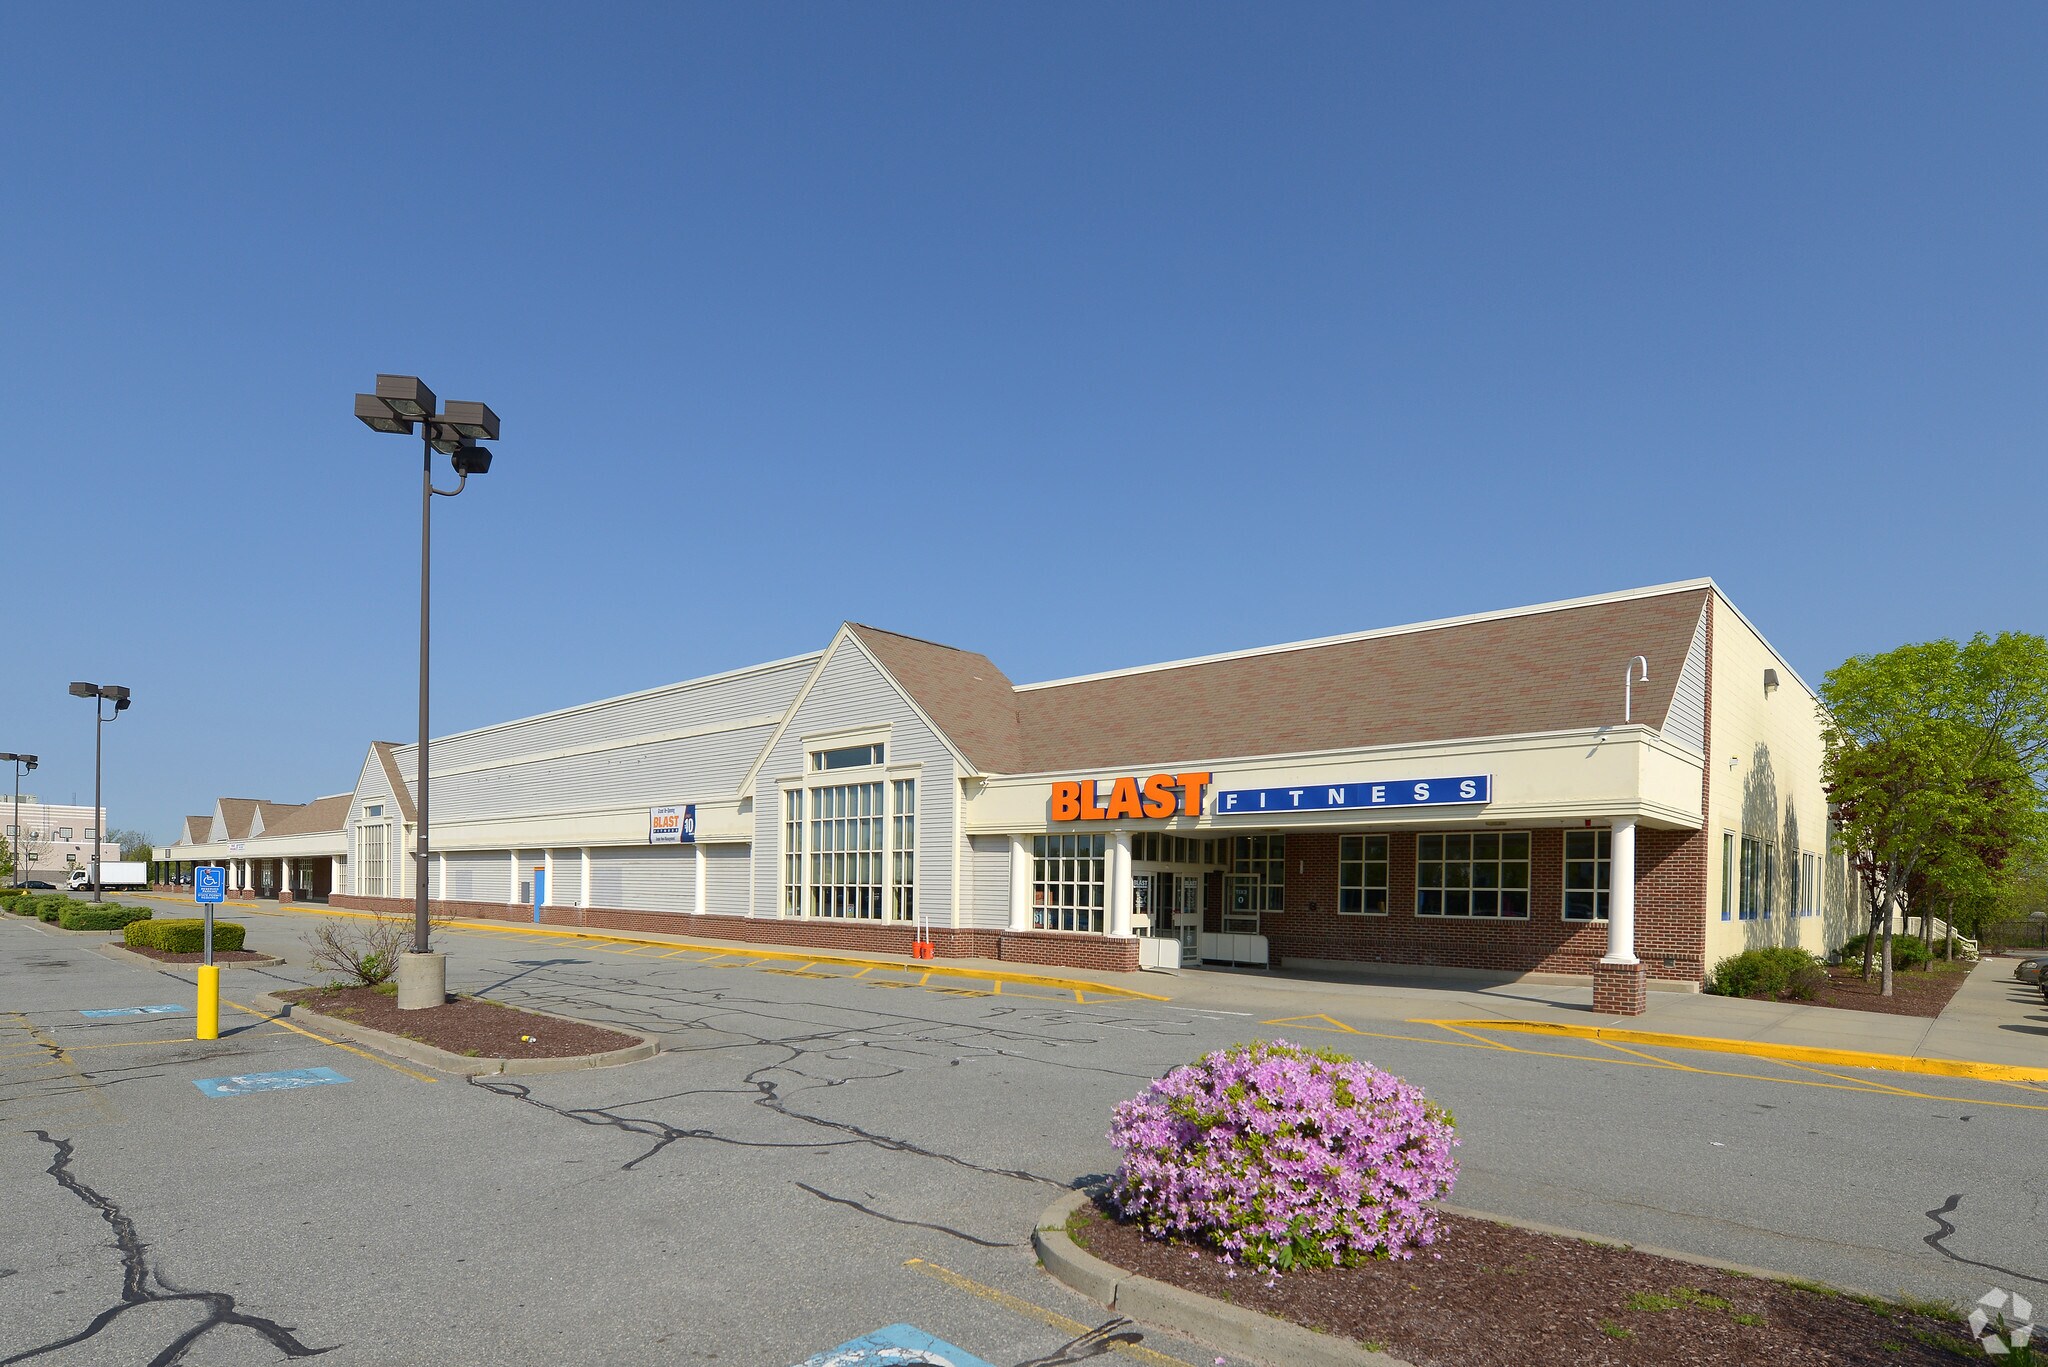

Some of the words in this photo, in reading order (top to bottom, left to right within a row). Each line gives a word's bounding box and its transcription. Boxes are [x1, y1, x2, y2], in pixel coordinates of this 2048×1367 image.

[1051, 772, 1210, 821] BLAST
[1226, 780, 1477, 810] FITNESS
[653, 815, 679, 828] BLAST
